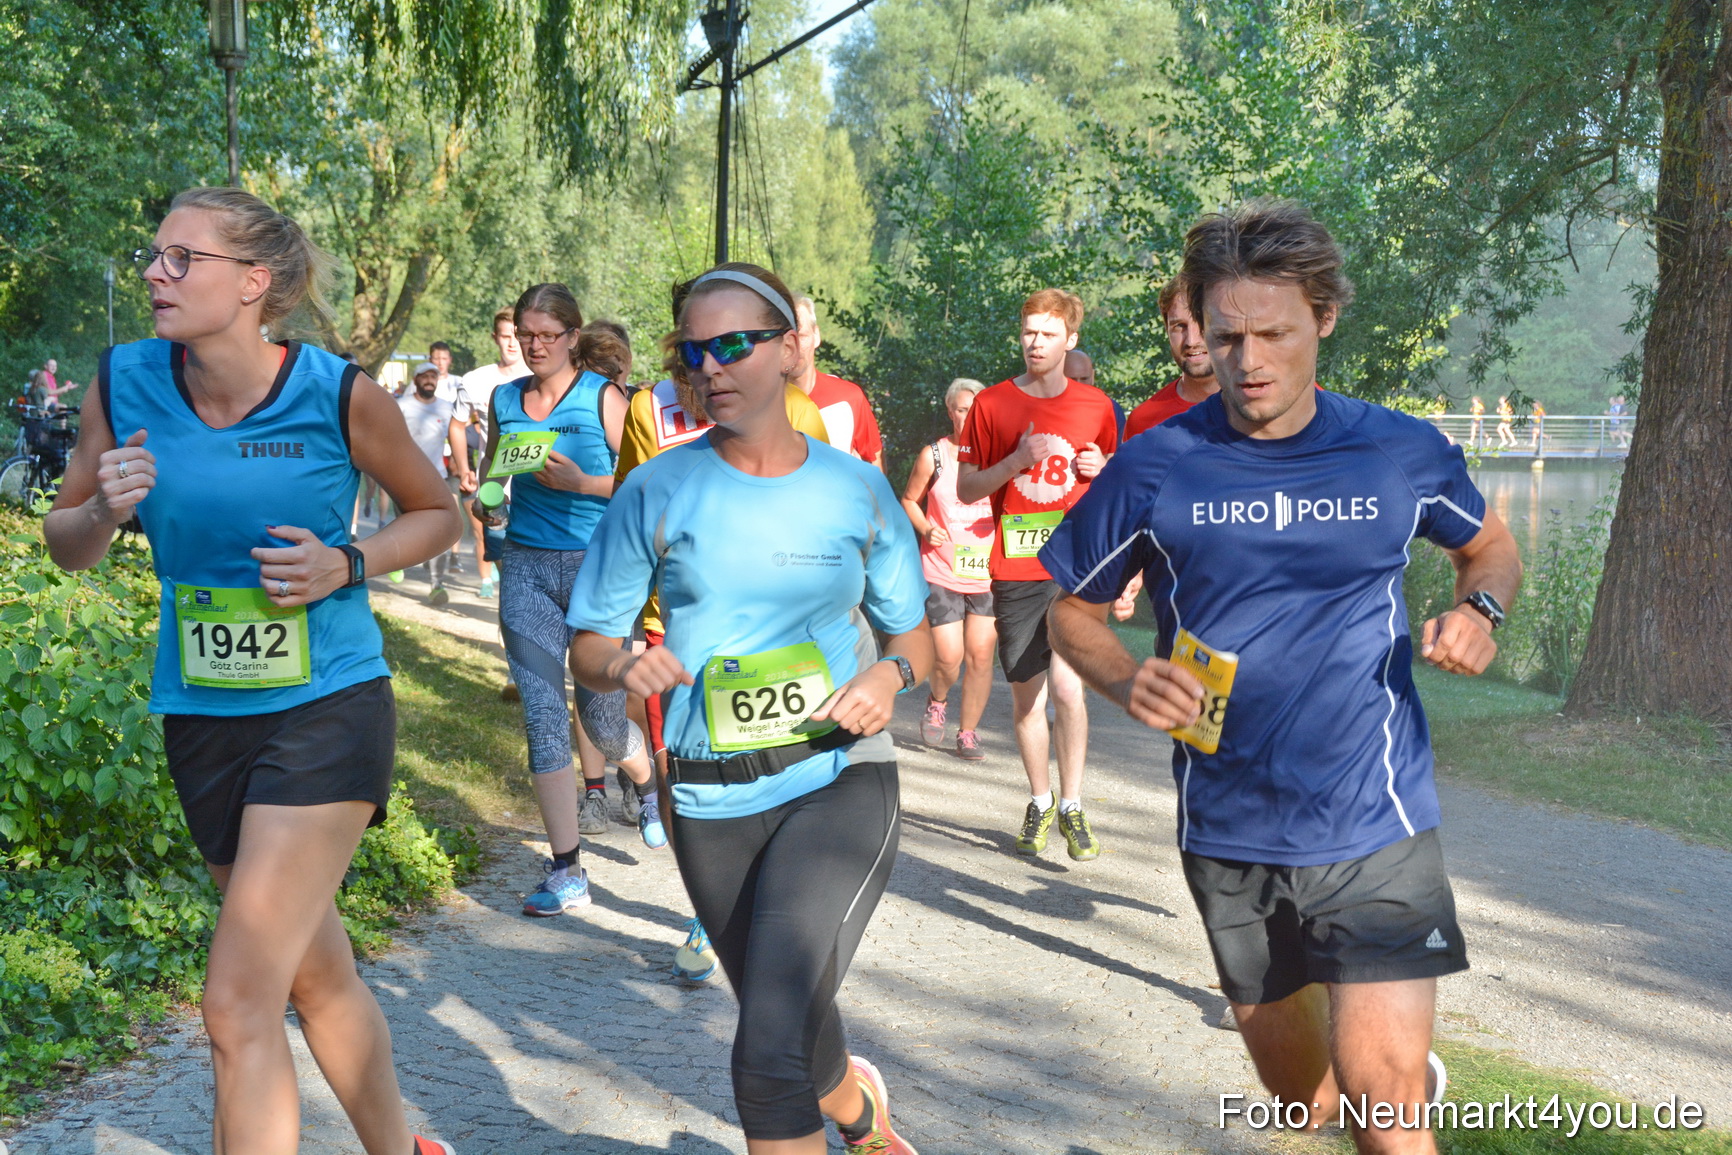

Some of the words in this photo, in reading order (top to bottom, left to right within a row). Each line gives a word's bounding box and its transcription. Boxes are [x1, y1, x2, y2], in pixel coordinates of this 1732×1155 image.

[238, 442, 304, 458] THULE
[501, 445, 542, 464] 1943
[1020, 455, 1068, 486] 48
[1192, 501, 1269, 525] EURO
[1298, 497, 1378, 522] POLES
[1016, 528, 1050, 545] 778
[191, 622, 289, 660] 1942
[209, 660, 231, 671] Götz
[234, 661, 268, 670] Carina
[731, 681, 806, 723] 626
[736, 720, 771, 734] Weigel
